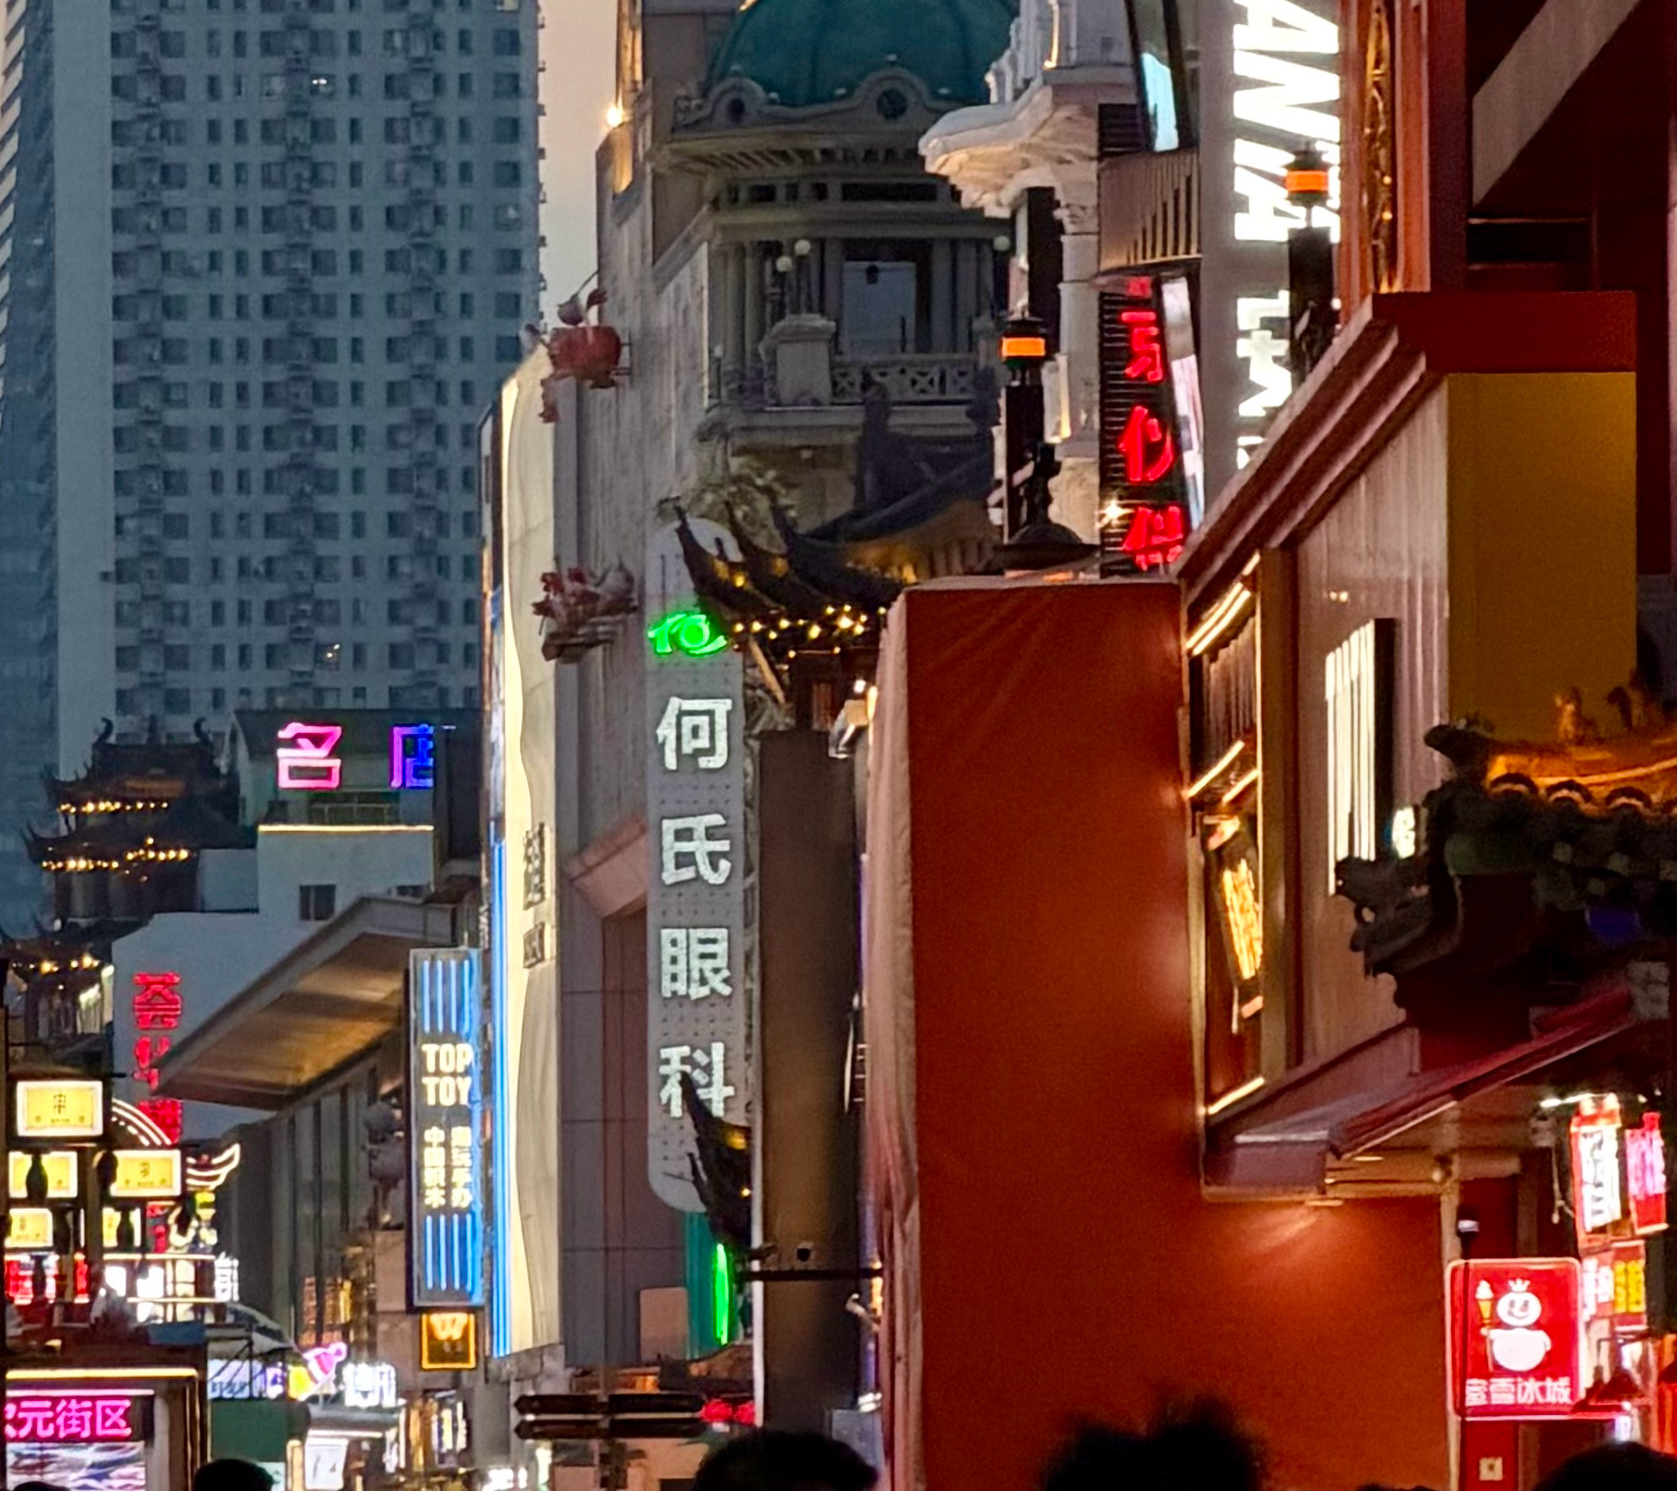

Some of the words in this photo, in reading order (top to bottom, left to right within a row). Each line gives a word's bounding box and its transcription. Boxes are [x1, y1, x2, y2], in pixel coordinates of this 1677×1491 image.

[655, 695, 735, 1118] 何氏眼科
[421, 1042, 473, 1074] TOP
[421, 1075, 473, 1107] TOY
[1464, 1376, 1572, 1407] 蜜雪冰城
